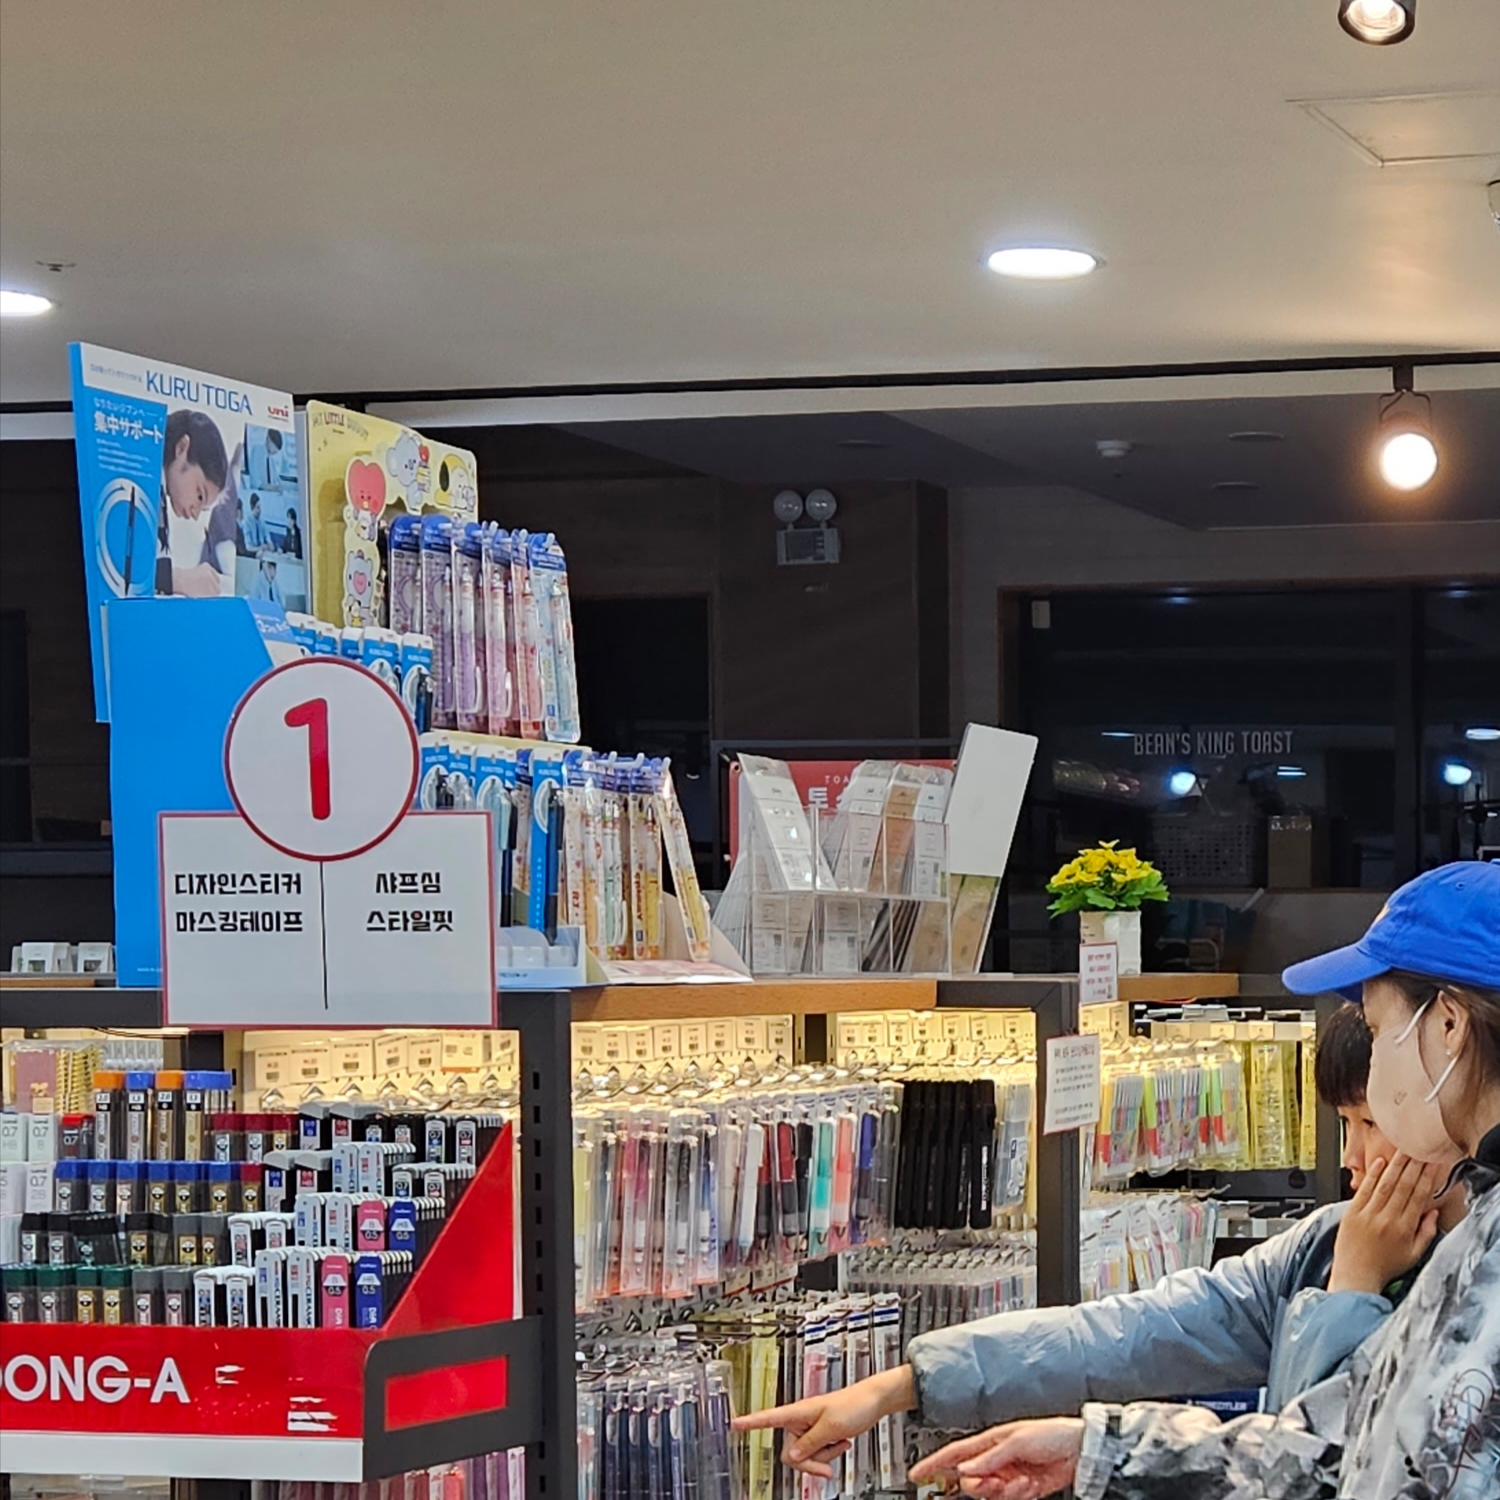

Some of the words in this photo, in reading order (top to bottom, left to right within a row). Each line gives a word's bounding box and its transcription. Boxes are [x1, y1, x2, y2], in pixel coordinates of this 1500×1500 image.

[146, 371, 199, 402] KURU
[202, 383, 252, 415] TOGA
[94, 411, 164, 444] 集中サポート
[1133, 732, 1191, 755] BEAN'S
[1197, 731, 1235, 754] KING
[1241, 730, 1294, 754] TOAST
[284, 697, 331, 820] 1
[174, 873, 302, 895] 디자인스티커
[375, 872, 441, 895] 샤프심
[175, 911, 303, 933] 마스킹테이프
[366, 910, 454, 933] 스타일핏
[3, 1126, 18, 1138] 0.7
[33, 1126, 49, 1138] 0.7
[30, 1176, 47, 1187] 0.7
[364, 1230, 378, 1240] 0.5
[396, 1230, 410, 1240] 0.5
[328, 1286, 342, 1296] 0.5
[362, 1285, 376, 1294] 0.5
[0, 1354, 191, 1403] ONG-A
